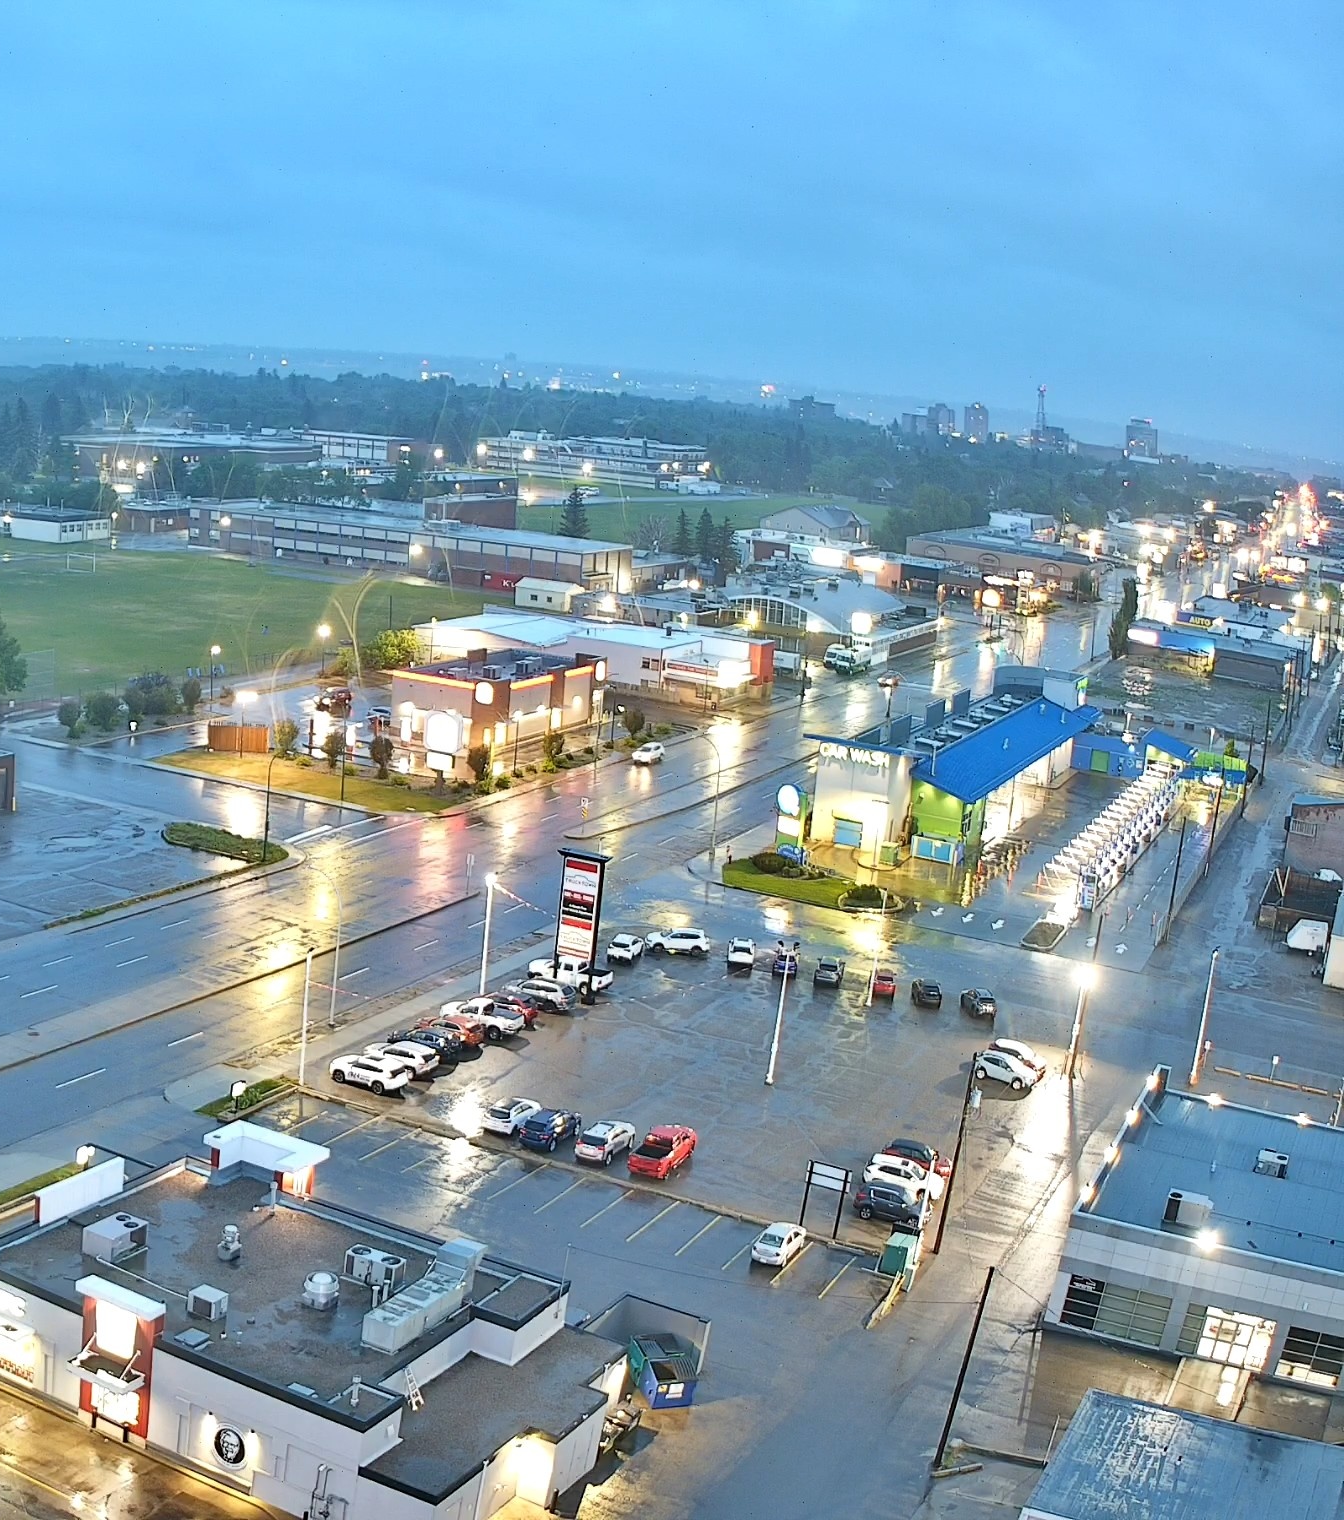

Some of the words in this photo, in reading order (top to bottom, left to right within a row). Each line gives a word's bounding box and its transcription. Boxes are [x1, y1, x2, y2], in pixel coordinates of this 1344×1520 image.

[1189, 616, 1211, 626] AUTO
[819, 743, 847, 761] CAR
[849, 747, 890, 768] WASH
